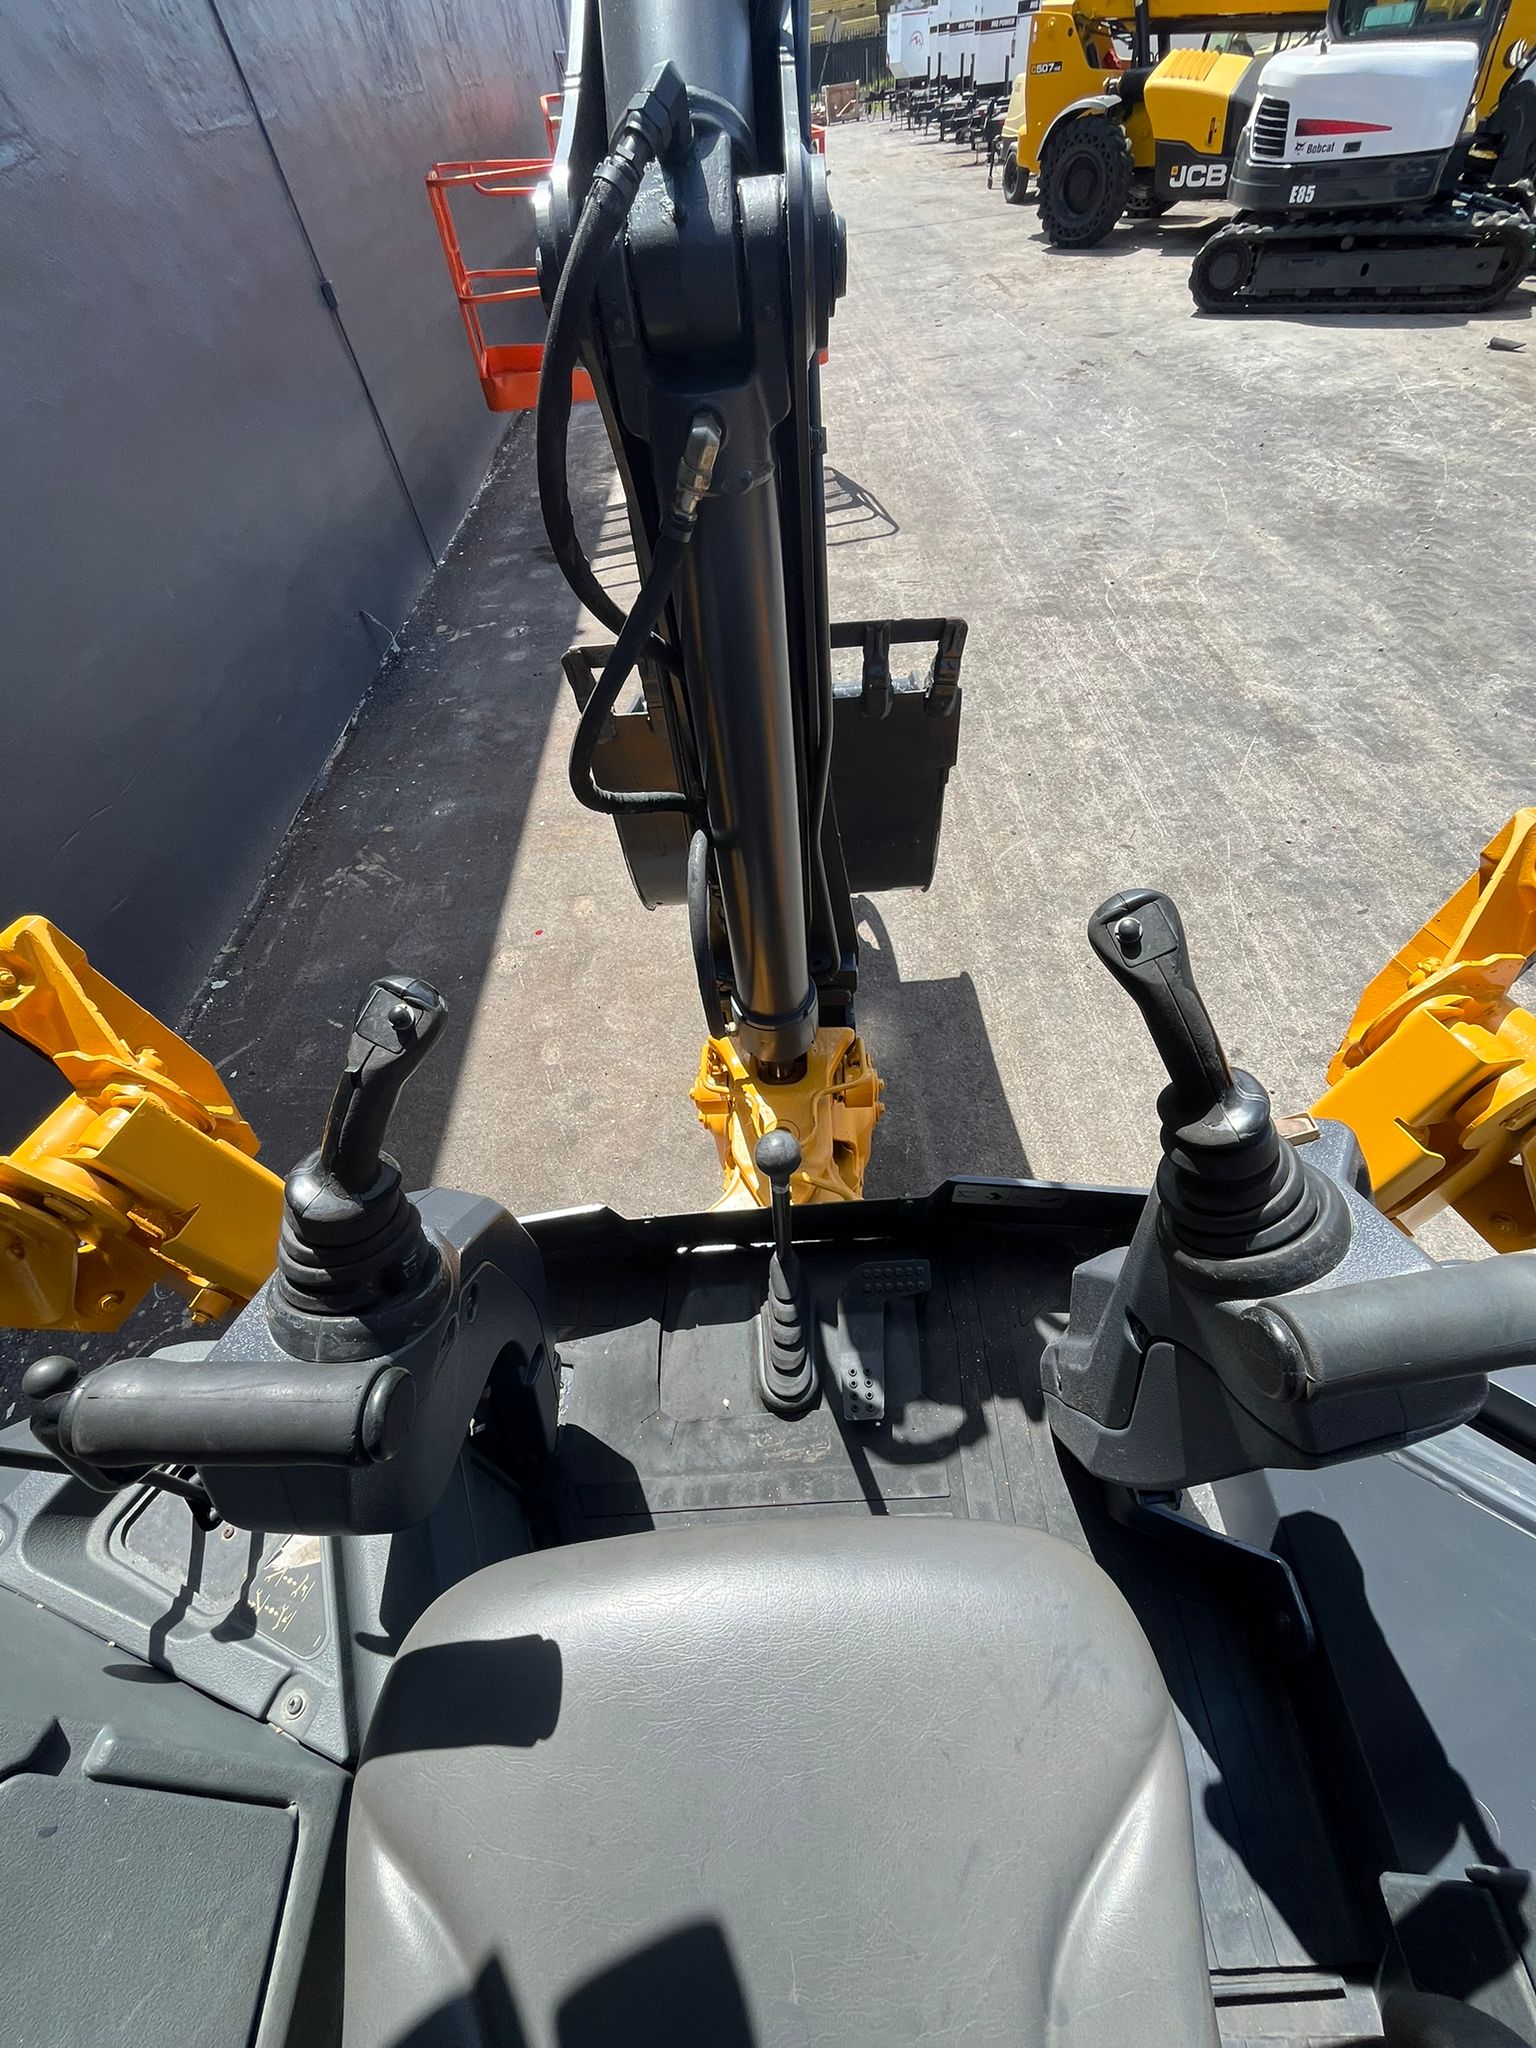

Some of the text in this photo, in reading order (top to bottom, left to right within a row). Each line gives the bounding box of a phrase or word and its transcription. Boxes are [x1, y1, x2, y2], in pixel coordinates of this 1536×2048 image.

[1306, 142, 1335, 154] Bobcat
[1169, 164, 1228, 188] JCB
[1288, 185, 1316, 204] E85
